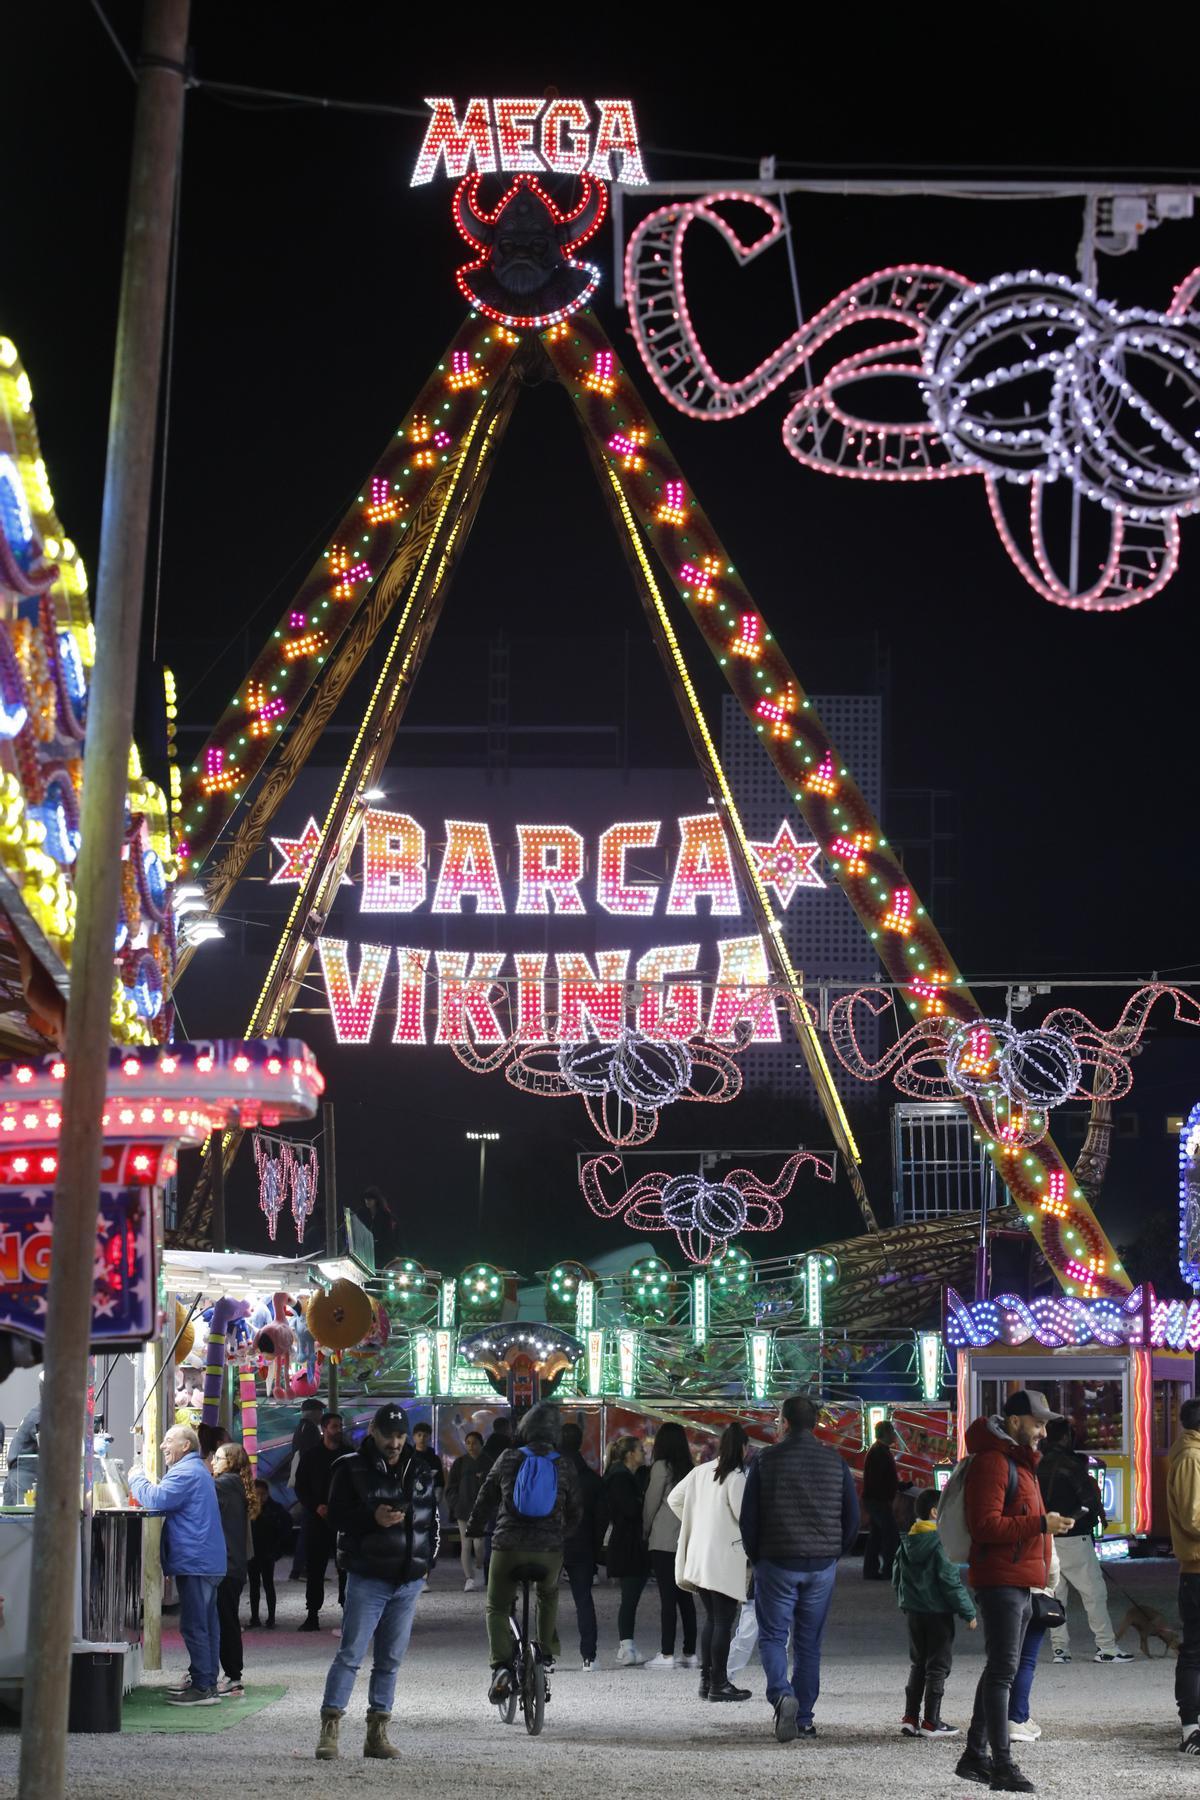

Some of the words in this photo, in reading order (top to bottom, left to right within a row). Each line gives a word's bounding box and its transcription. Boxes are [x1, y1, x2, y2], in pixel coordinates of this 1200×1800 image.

[410, 97, 649, 187] MEGA
[359, 809, 741, 914] BARCA
[318, 936, 781, 1044] VIKINGA
